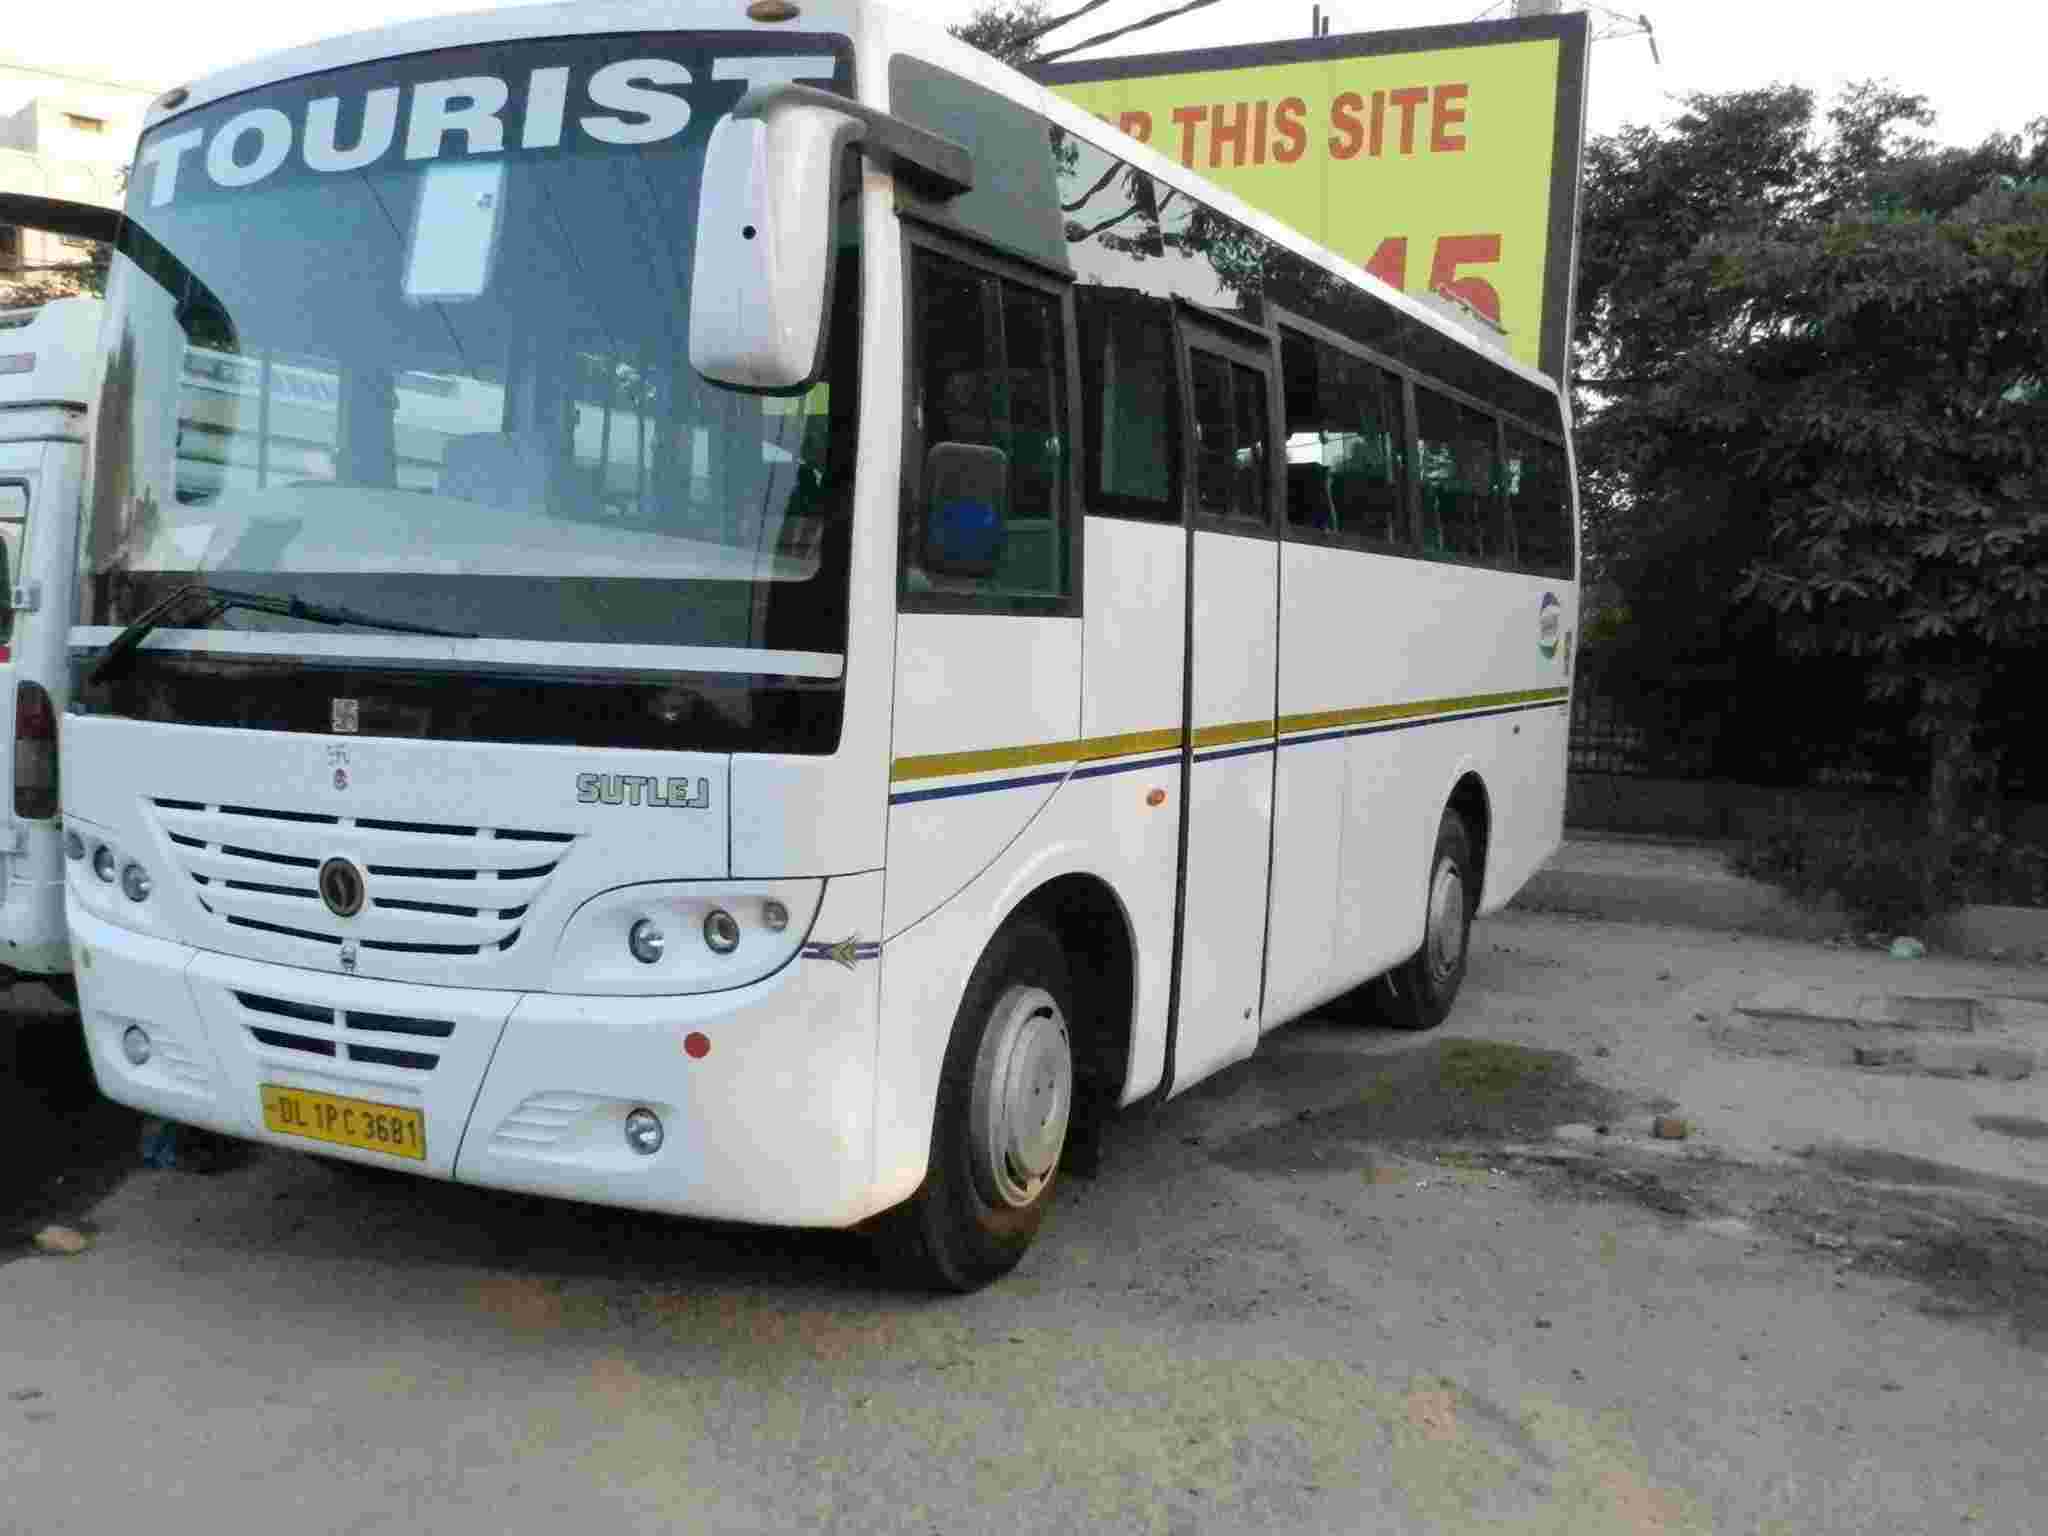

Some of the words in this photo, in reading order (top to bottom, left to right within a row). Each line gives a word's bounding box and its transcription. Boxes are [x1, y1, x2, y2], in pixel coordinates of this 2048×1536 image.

[147, 55, 838, 208] TOURIST
[1172, 96, 1307, 169] THIS
[1328, 82, 1468, 160] SITE
[577, 772, 709, 808] SUTLEJ
